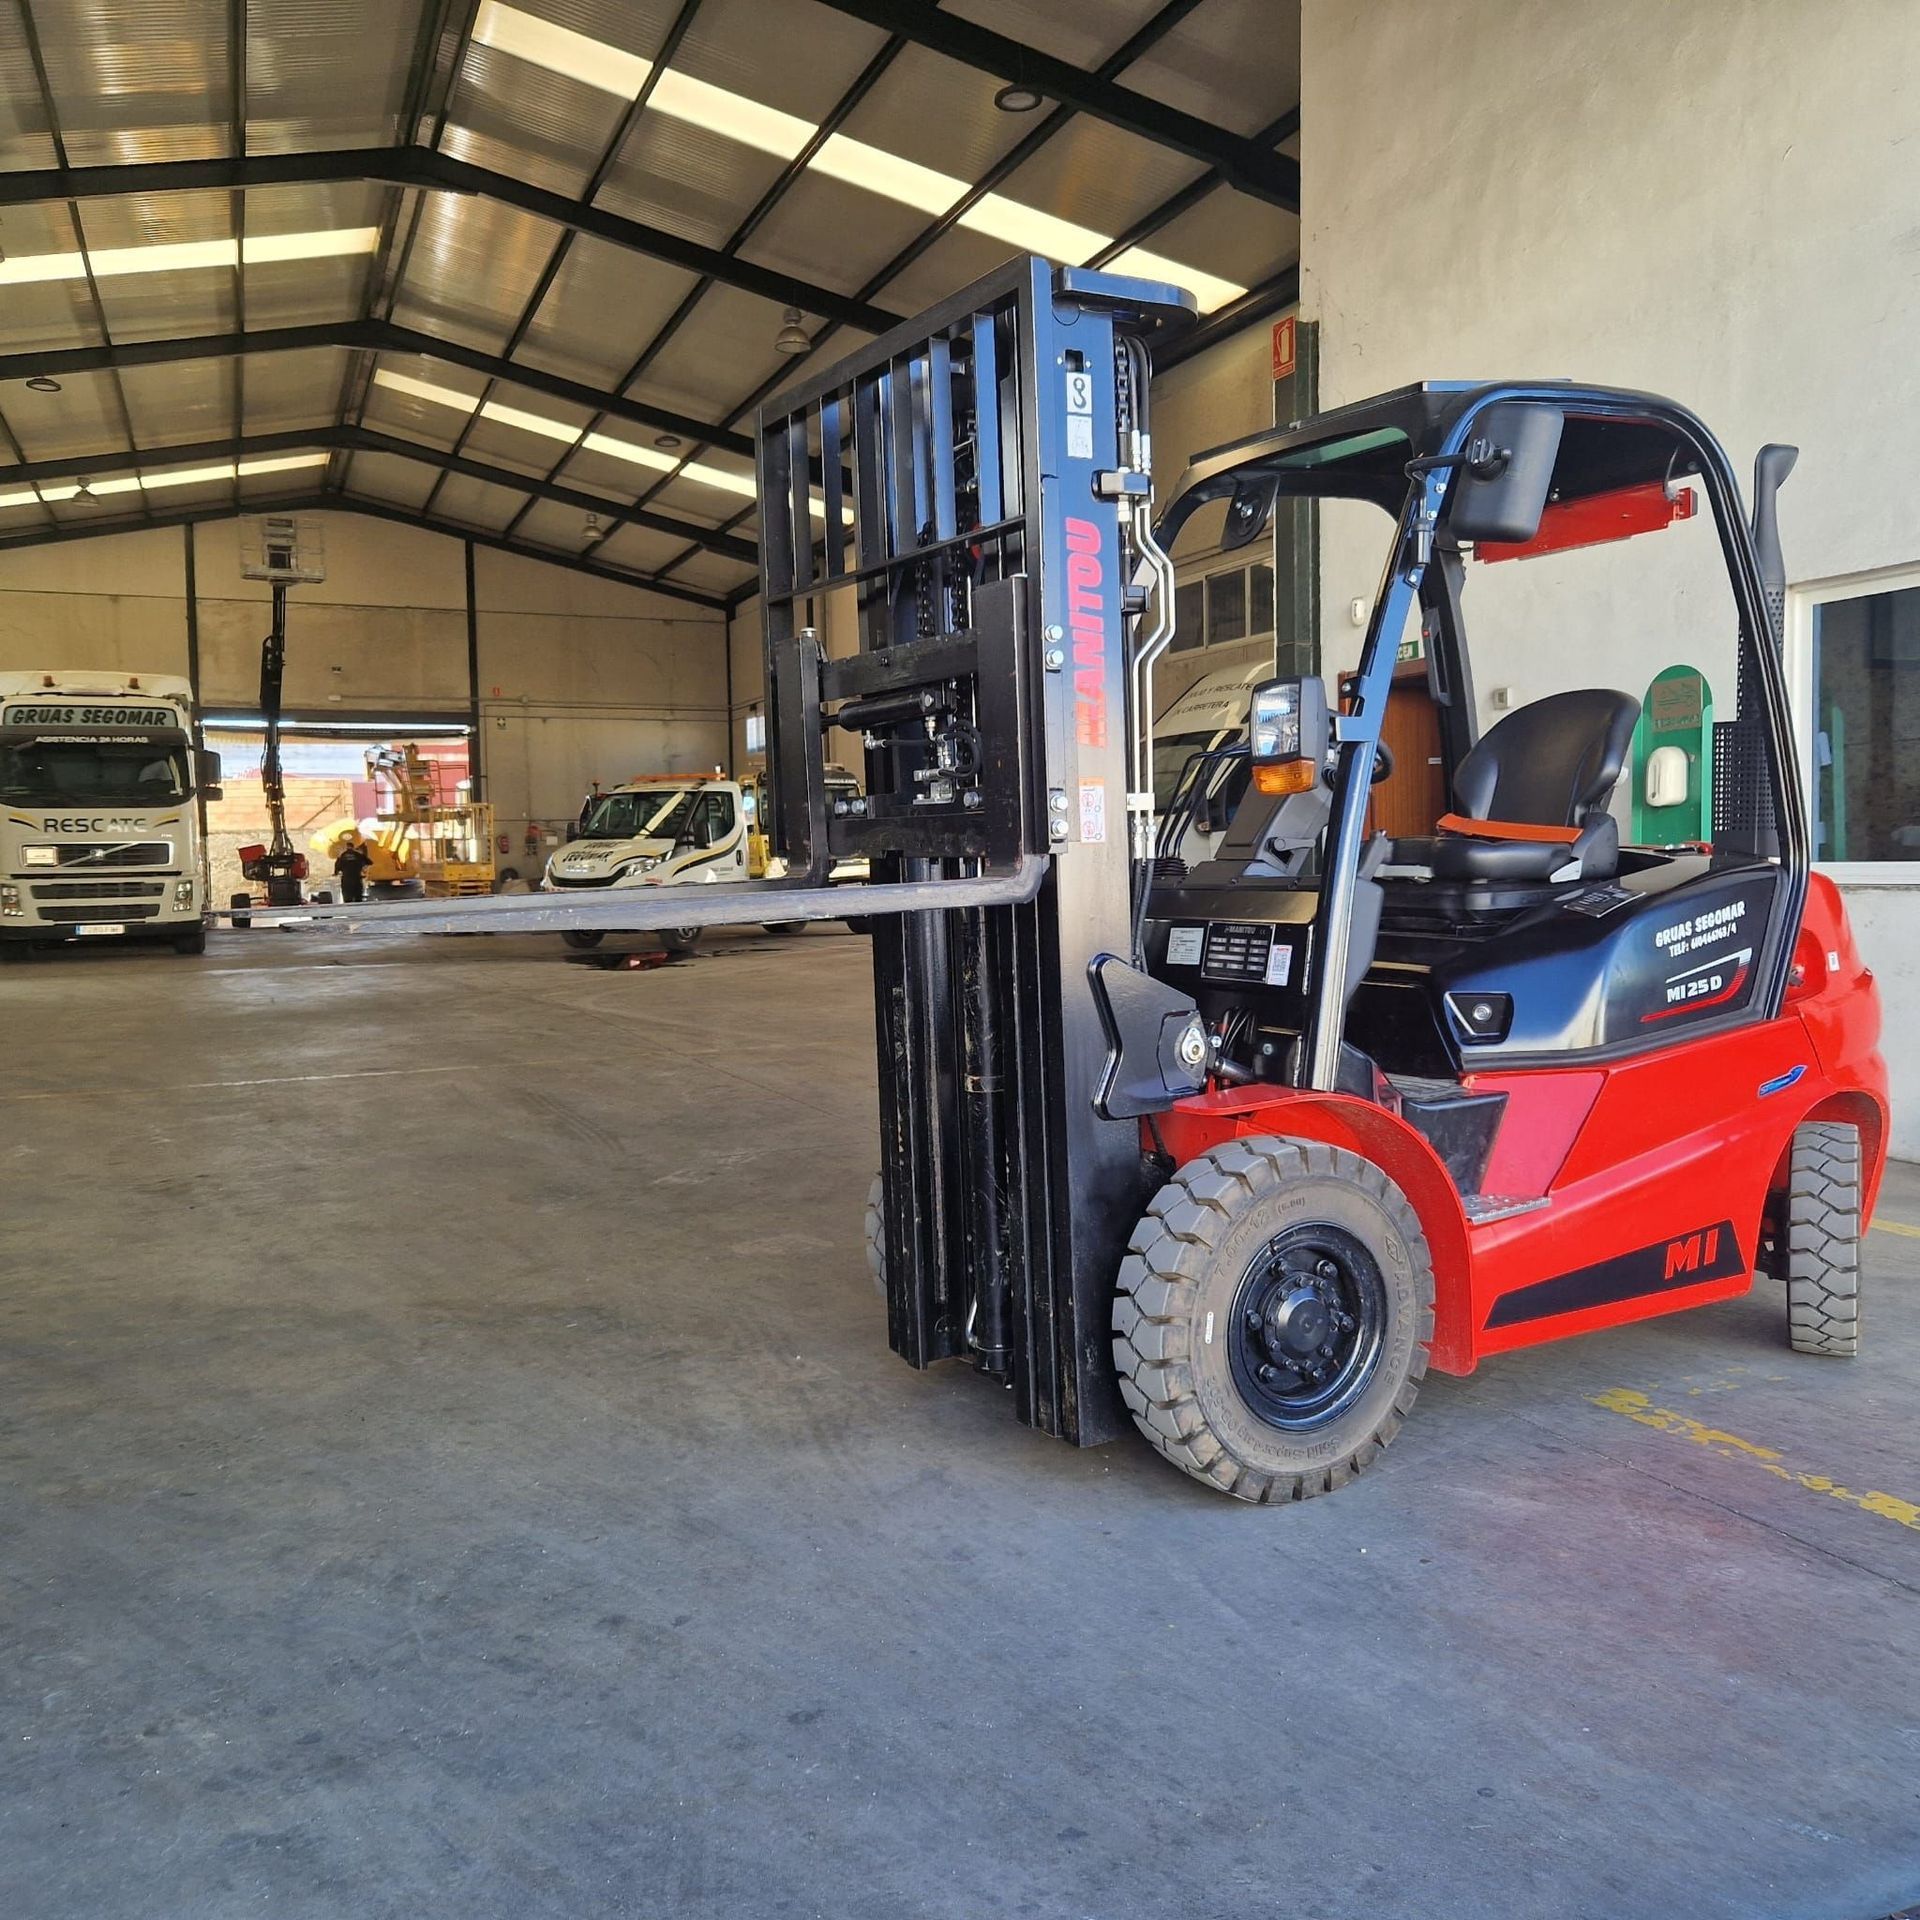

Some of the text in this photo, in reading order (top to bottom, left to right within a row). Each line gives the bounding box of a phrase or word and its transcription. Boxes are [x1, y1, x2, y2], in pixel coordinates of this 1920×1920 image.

[1065, 517, 1105, 747] MANITOU
[12, 709, 167, 726] GRUAS SEGOMAR
[43, 818, 148, 833] RESCATE
[1655, 900, 1745, 948] GRUAS SEGOMAR
[1664, 1228, 1719, 1280] MI
